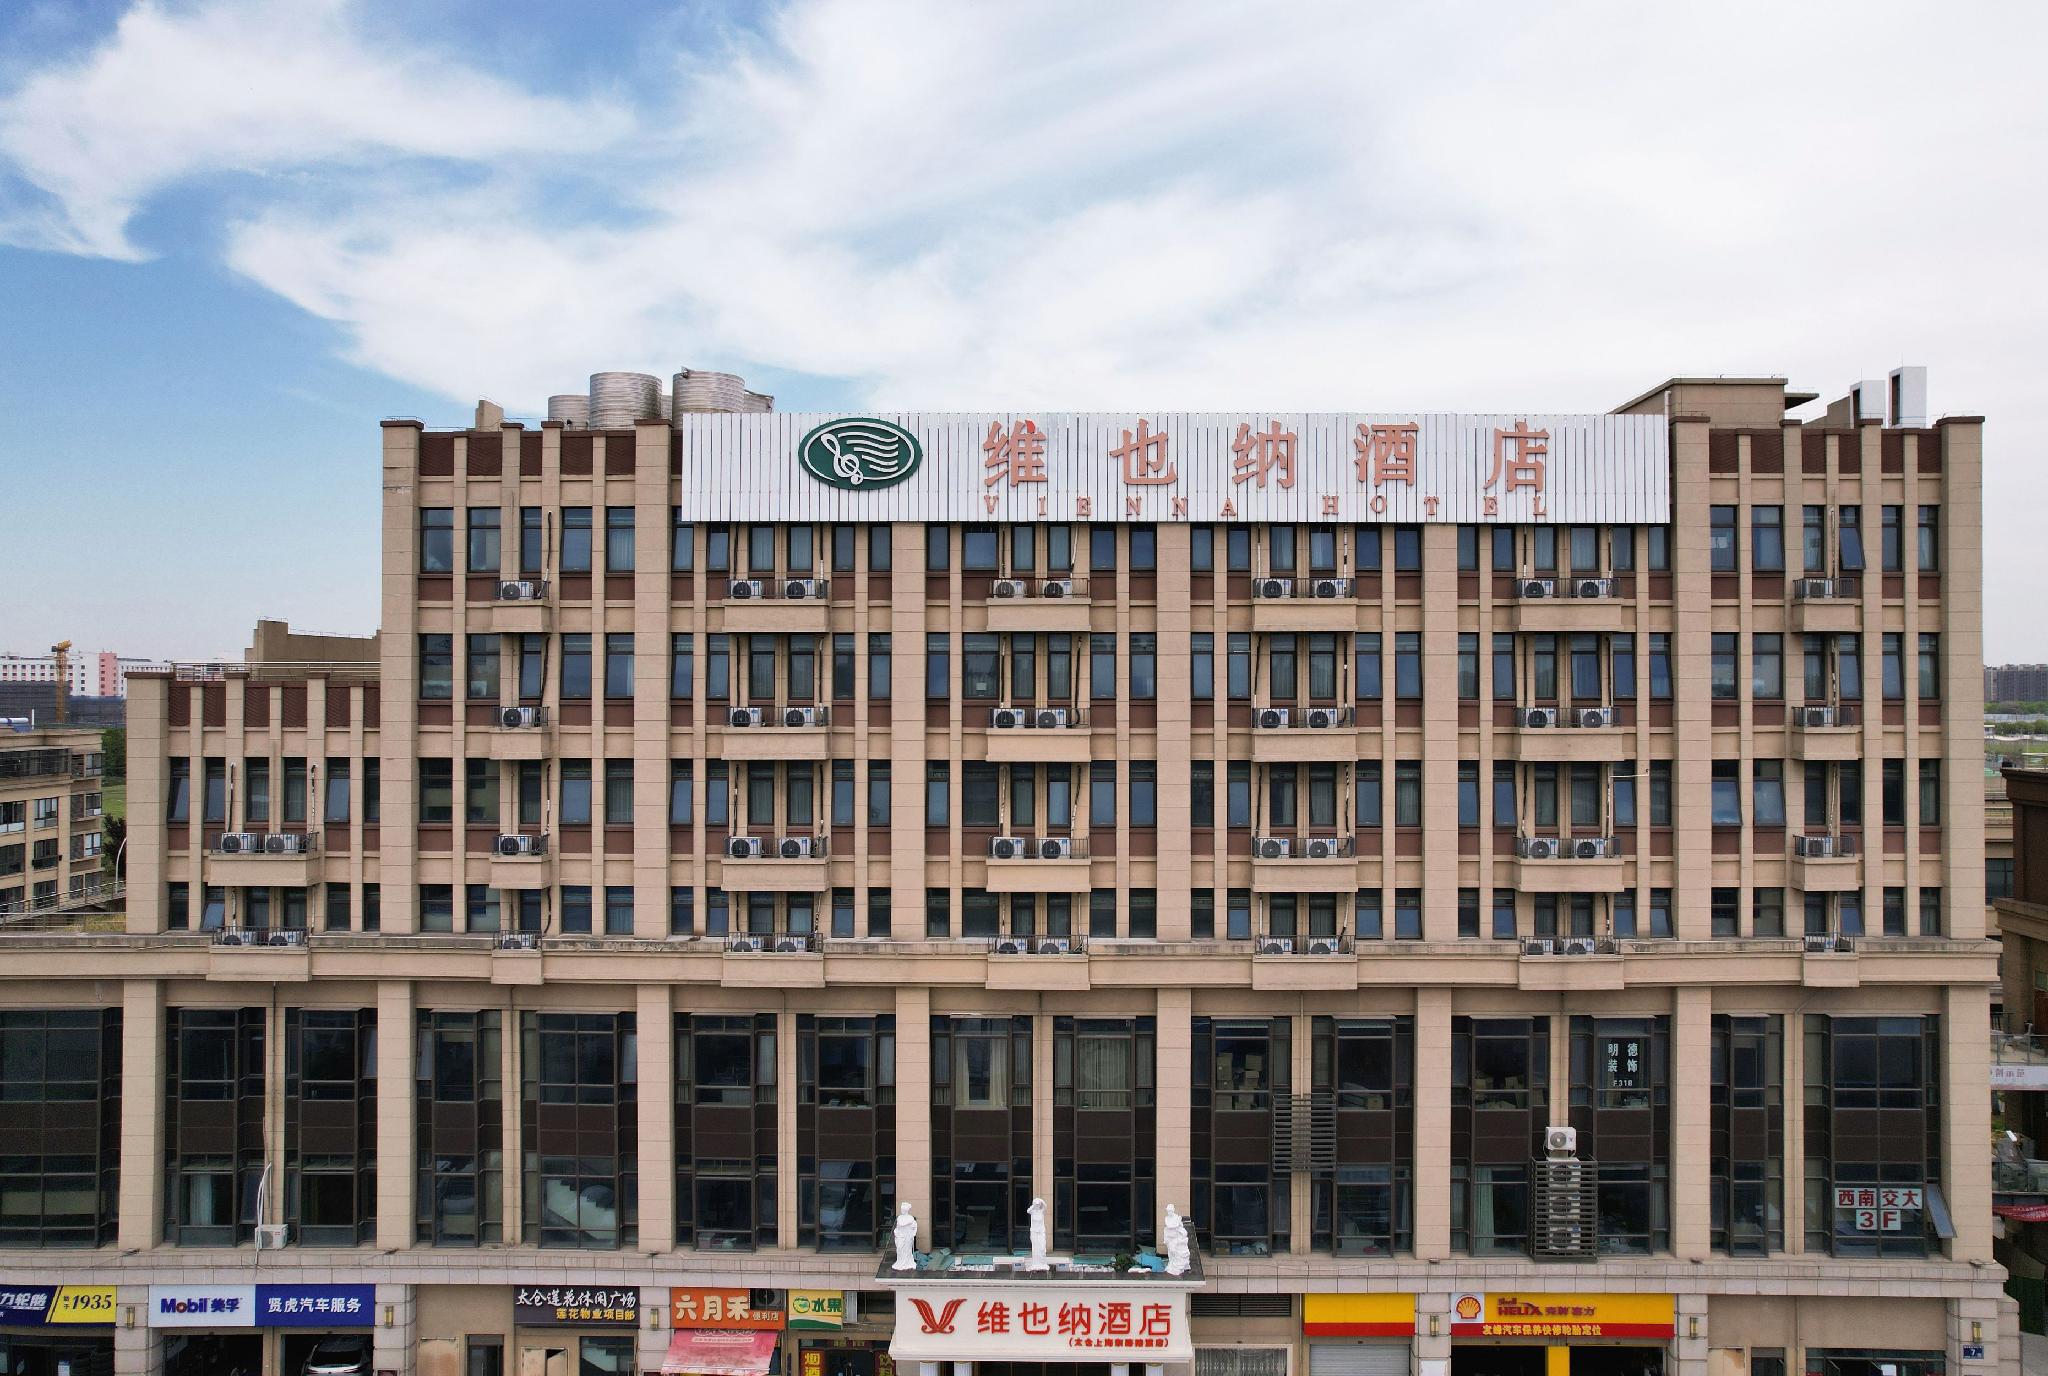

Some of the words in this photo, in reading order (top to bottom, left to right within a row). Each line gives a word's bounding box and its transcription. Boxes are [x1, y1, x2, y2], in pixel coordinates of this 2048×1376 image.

[982, 418, 1550, 492] 维也纳酒店
[983, 495, 1237, 516] VIENNA
[1321, 495, 1547, 516] HOTEL
[1607, 1042, 1638, 1057] 明德
[1607, 1058, 1638, 1072] 装饰
[1838, 1188, 1919, 1208] 西南交大
[1859, 1211, 1898, 1229] 3F
[72, 1294, 112, 1310] 1935
[160, 1297, 207, 1313] Mobil
[210, 1297, 240, 1313] 美孚
[268, 1297, 362, 1313] 贤虎汽车服务
[516, 1288, 637, 1308] 太仓莲花休闲广场
[811, 1298, 842, 1313] 水果
[556, 1308, 636, 1321] 莲花物业项目部
[675, 1294, 750, 1321] 六月禾
[1498, 1306, 1543, 1316] HELIX
[752, 1311, 779, 1321] 便利店
[976, 1301, 1173, 1336] 维也纳酒店
